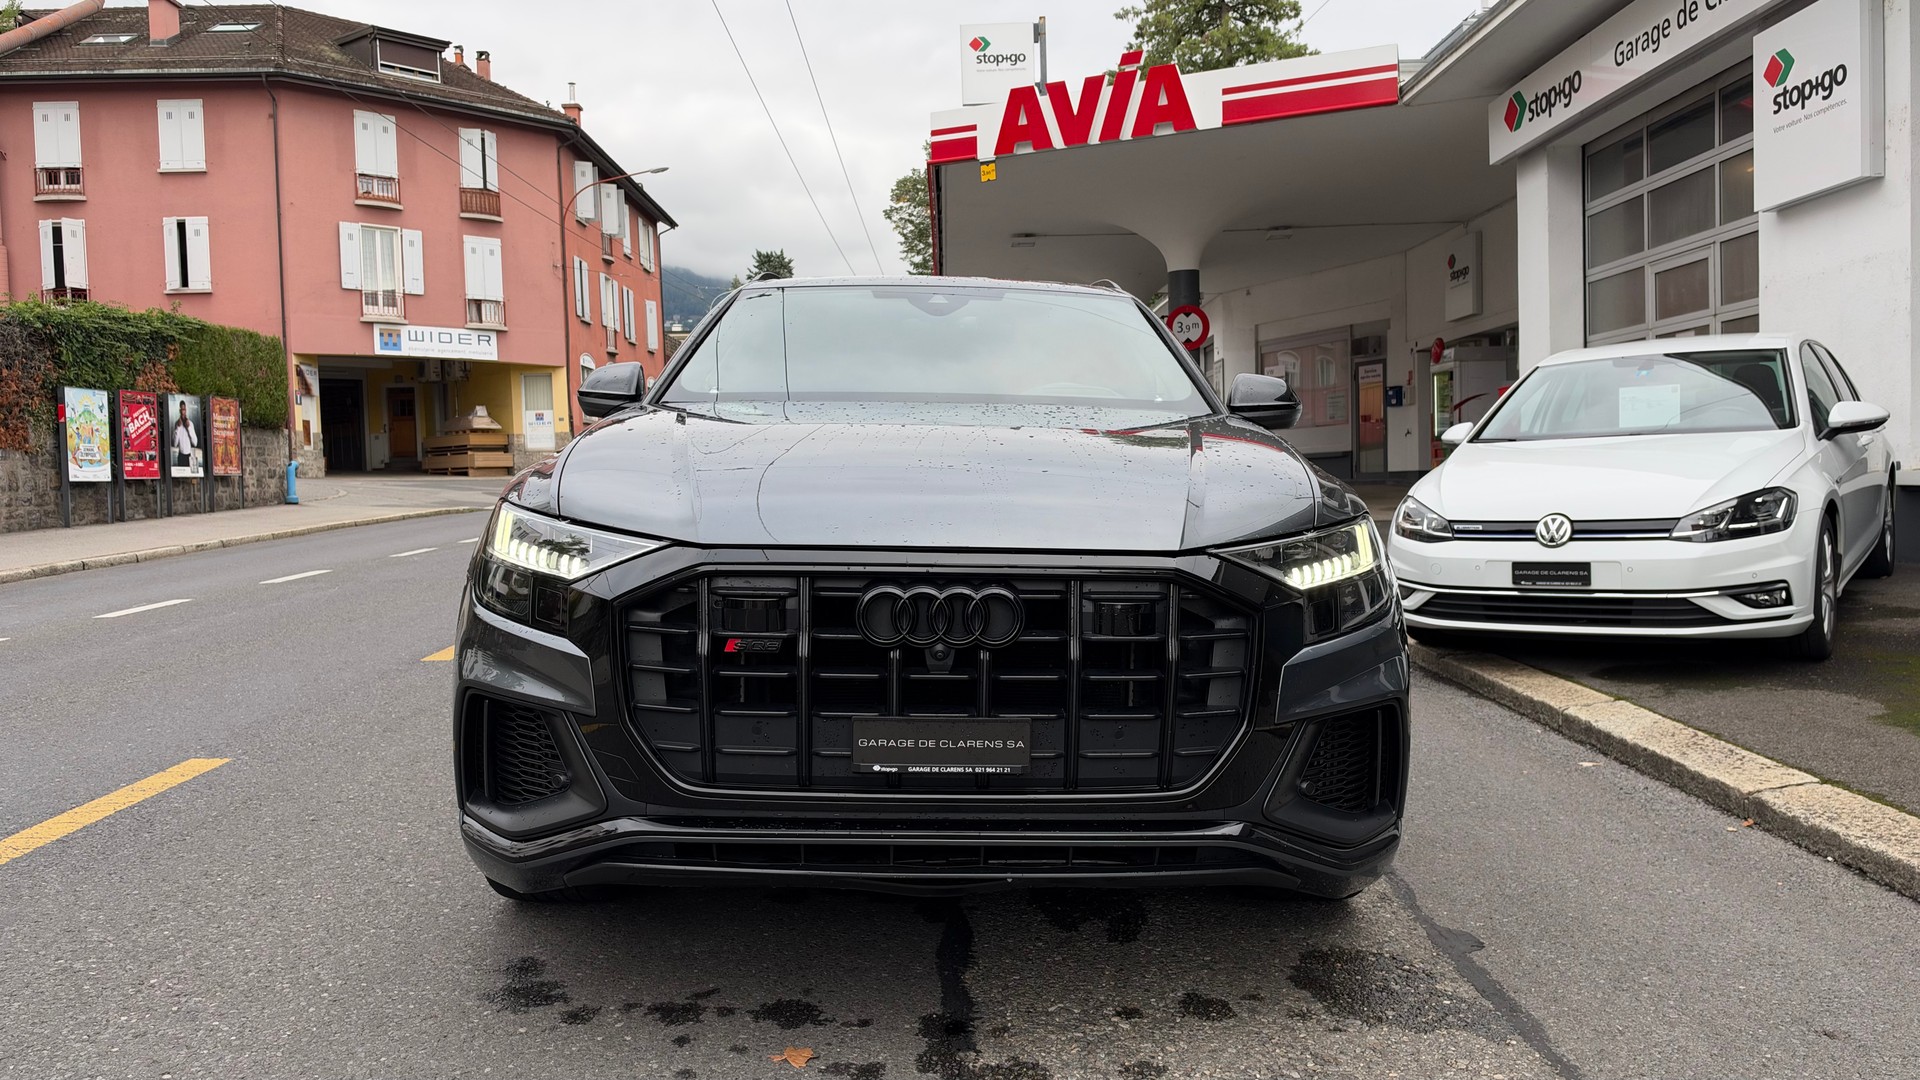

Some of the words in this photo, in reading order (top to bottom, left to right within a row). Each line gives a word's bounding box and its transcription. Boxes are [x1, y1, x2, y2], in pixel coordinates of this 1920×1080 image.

[1613, 17, 1671, 67] Garage
[1676, 0, 1699, 29] de
[976, 52, 1026, 66] stop+go
[1528, 70, 1582, 122] stop+go
[1772, 63, 1848, 115] stop+go
[994, 50, 1197, 156] AVIA
[1773, 123, 1785, 133] Votre
[1803, 113, 1813, 121] Nos
[407, 329, 492, 346] WIDER
[127, 410, 151, 434] BACH
[858, 738, 916, 748] GARAGE
[918, 739, 936, 748] DE
[939, 739, 1004, 748] CLARENS
[1006, 740, 1025, 749] SA
